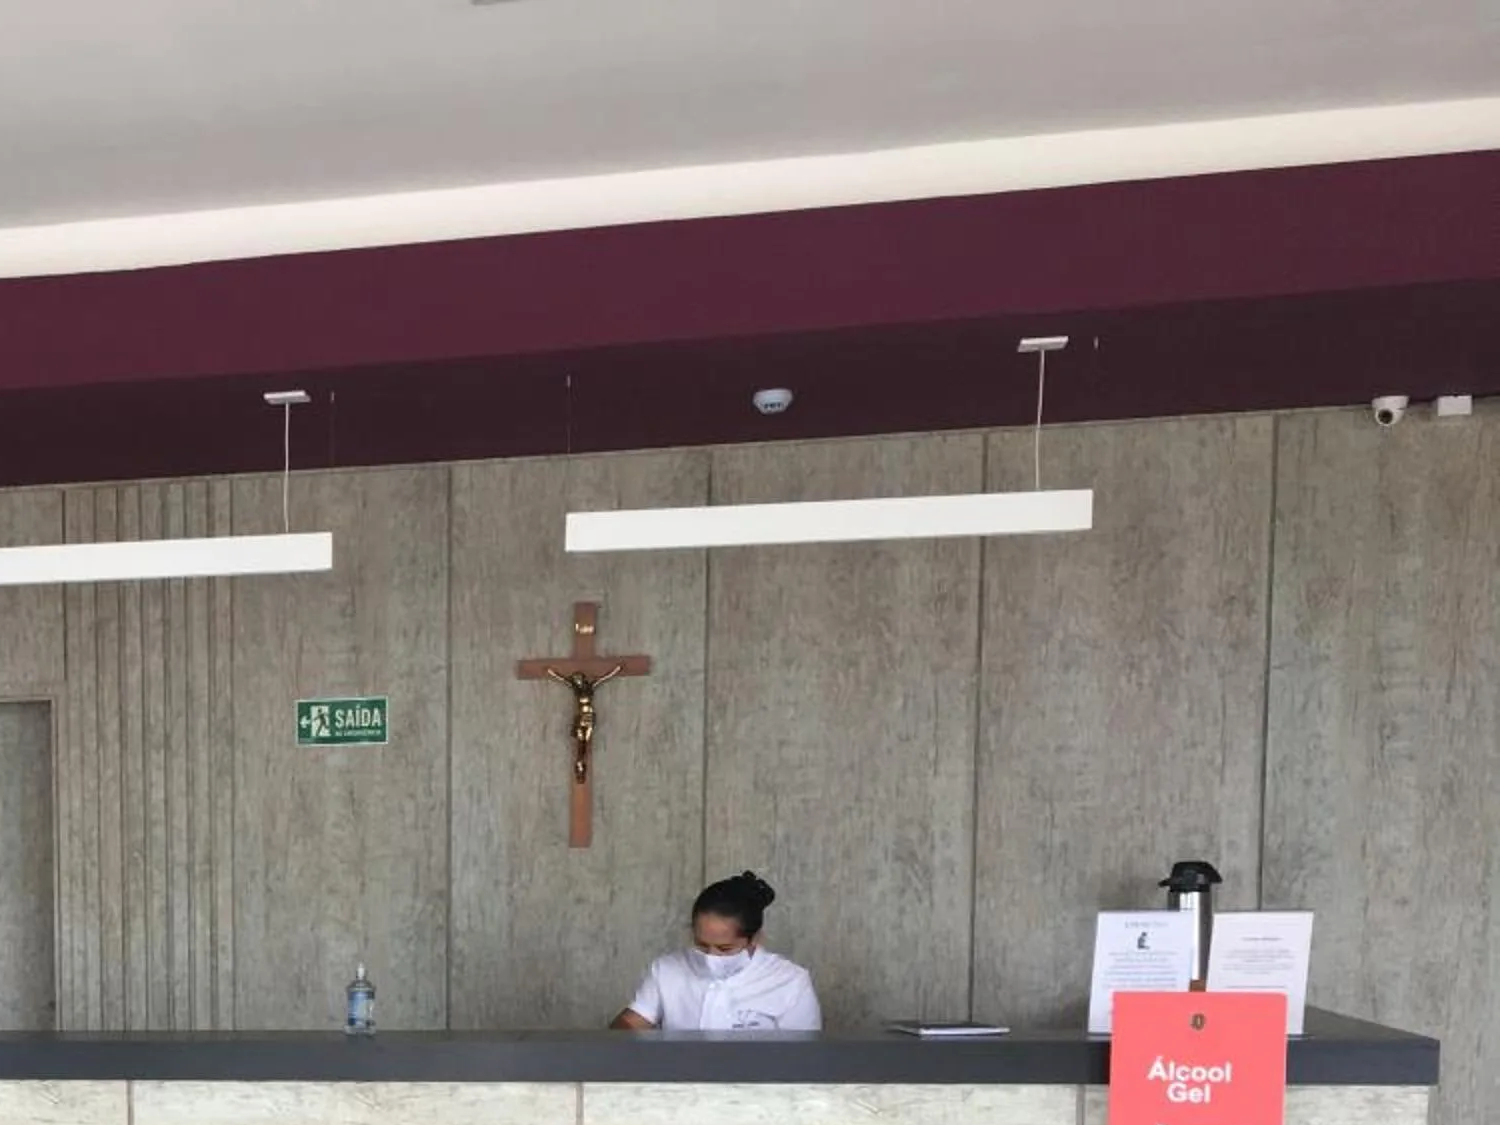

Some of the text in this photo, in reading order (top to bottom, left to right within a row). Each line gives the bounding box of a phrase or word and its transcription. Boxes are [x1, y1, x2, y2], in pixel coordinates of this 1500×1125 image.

[335, 705, 381, 728] SAÍDA
[1147, 1056, 1232, 1083] Álcool
[1167, 1082, 1211, 1104] Gel
